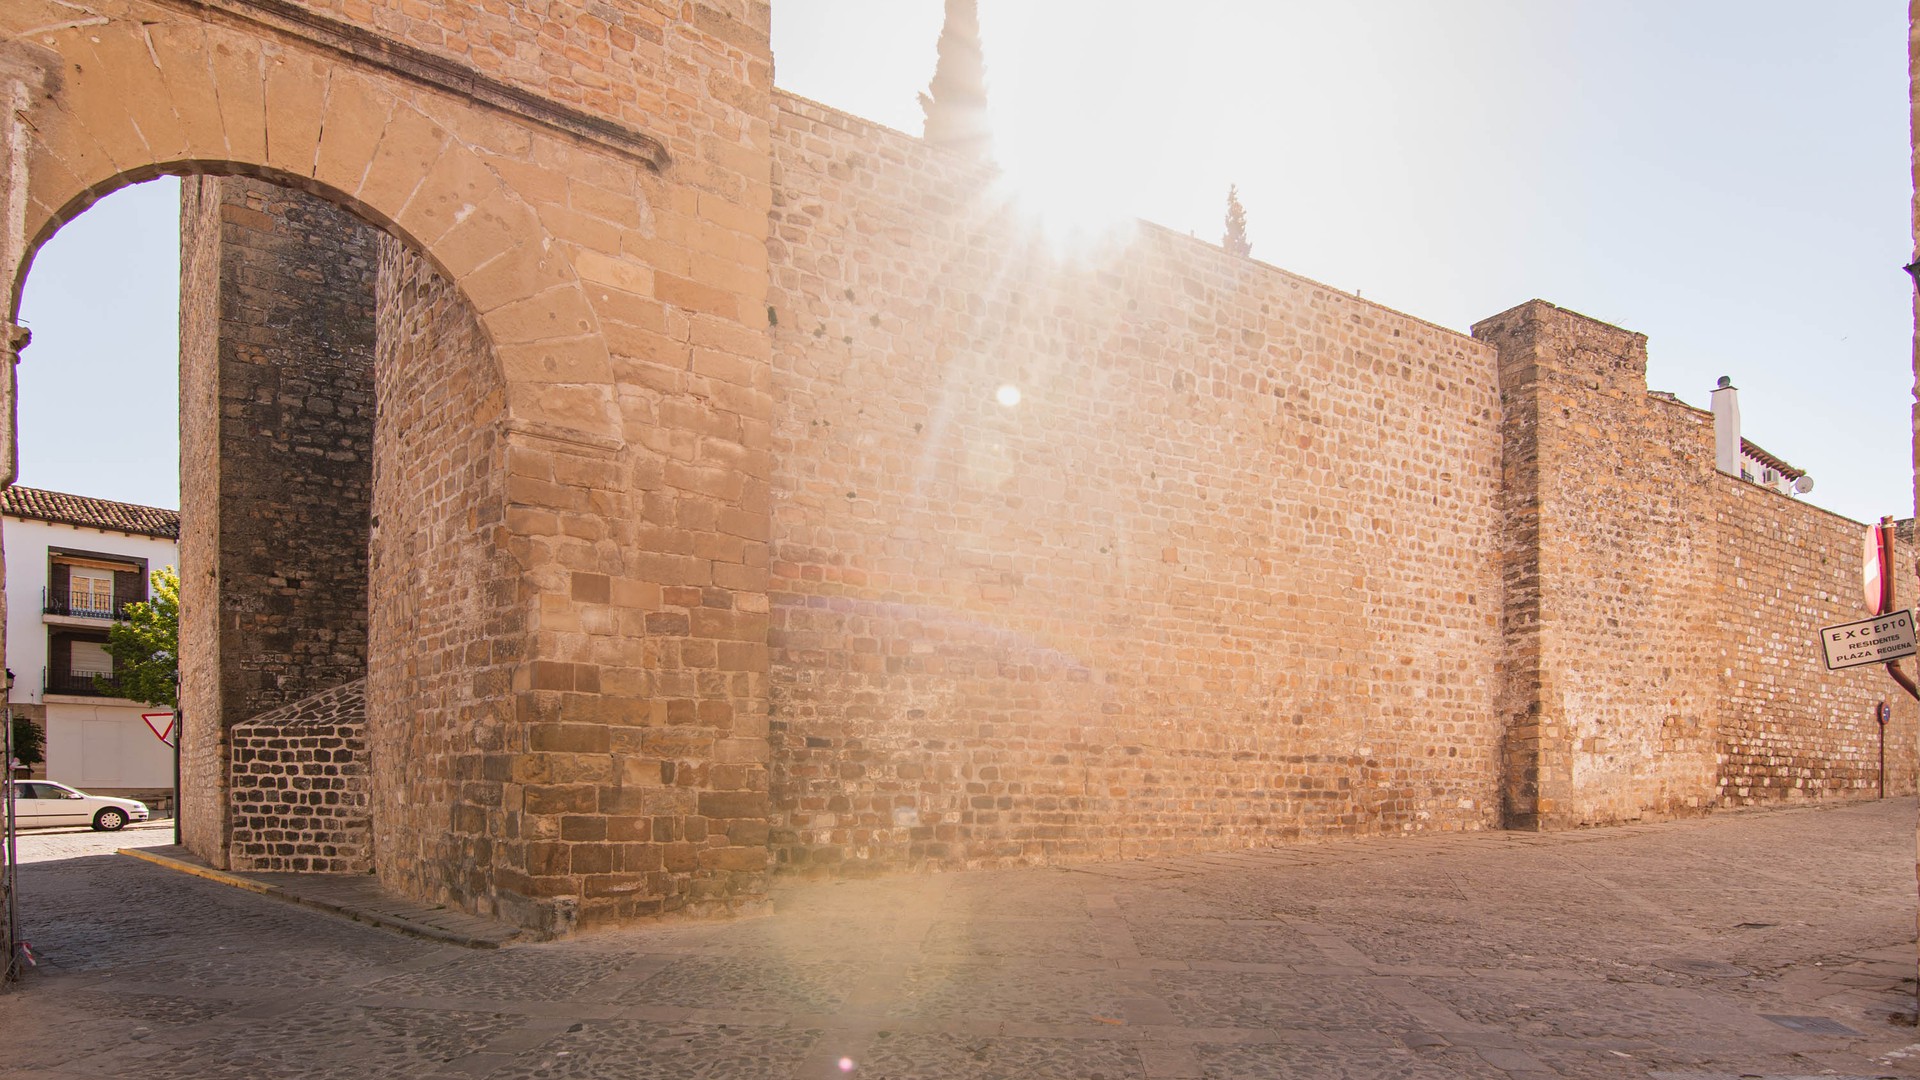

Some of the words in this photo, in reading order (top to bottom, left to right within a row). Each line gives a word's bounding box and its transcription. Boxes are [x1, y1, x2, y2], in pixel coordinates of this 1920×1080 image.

[1832, 619, 1906, 641] EXCEPTO
[1836, 650, 1872, 662] PLAZA
[1877, 642, 1912, 655] REQUENA
[1849, 634, 1900, 650] RESIDENTES
